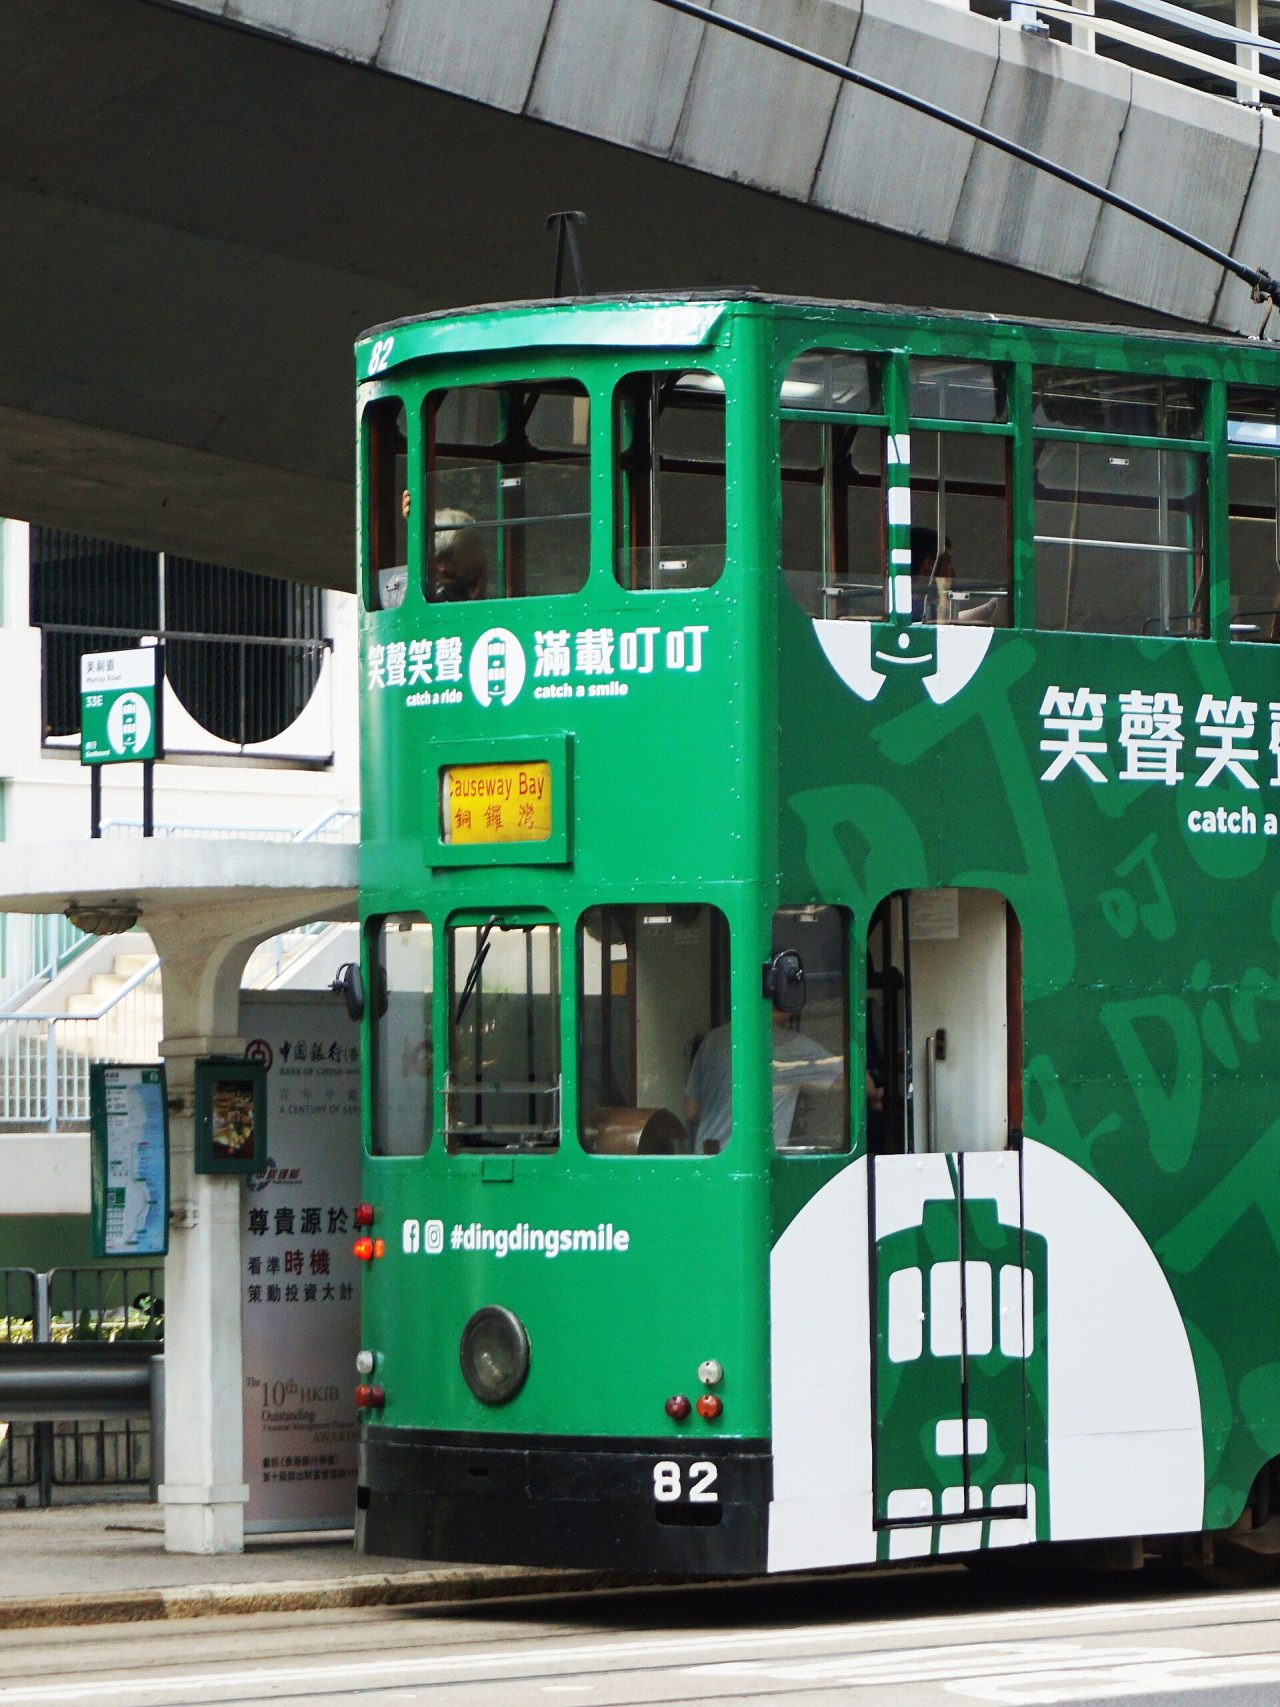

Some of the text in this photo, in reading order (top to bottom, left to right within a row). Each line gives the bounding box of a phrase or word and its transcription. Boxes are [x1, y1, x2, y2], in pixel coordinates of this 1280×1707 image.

[368, 336, 395, 375] 82
[368, 625, 709, 690] 笑聲笑聲 滿載叮叮
[85, 695, 103, 708] 33E
[406, 681, 628, 707] catch a ride catch a smile
[449, 771, 544, 801] auseway Bay
[455, 802, 535, 831] 銅鑼灣
[1188, 805, 1256, 834] catch
[1263, 812, 1277, 835] a
[451, 1223, 630, 1258] #dingdingsmile
[248, 1282, 354, 1303] 策動投資大計
[300, 1386, 340, 1402] HKIB
[653, 1461, 718, 1502] 82
